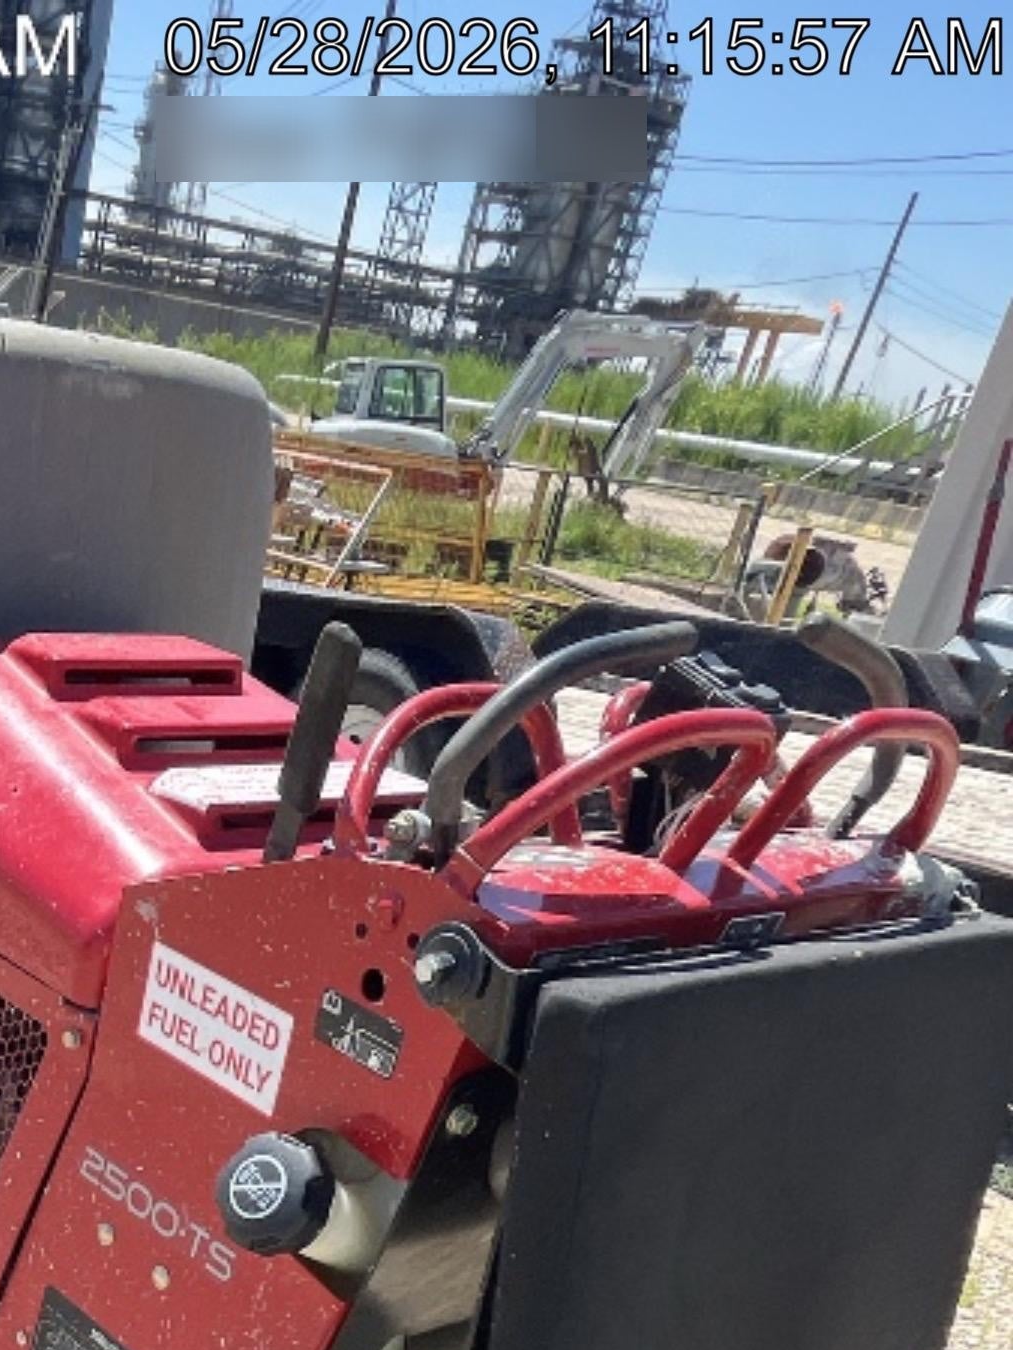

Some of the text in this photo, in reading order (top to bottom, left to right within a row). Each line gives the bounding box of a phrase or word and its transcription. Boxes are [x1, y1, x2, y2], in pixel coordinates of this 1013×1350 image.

[147, 1001, 273, 1093] FUEL ONLY
[156, 959, 281, 1051] UNLEADED
